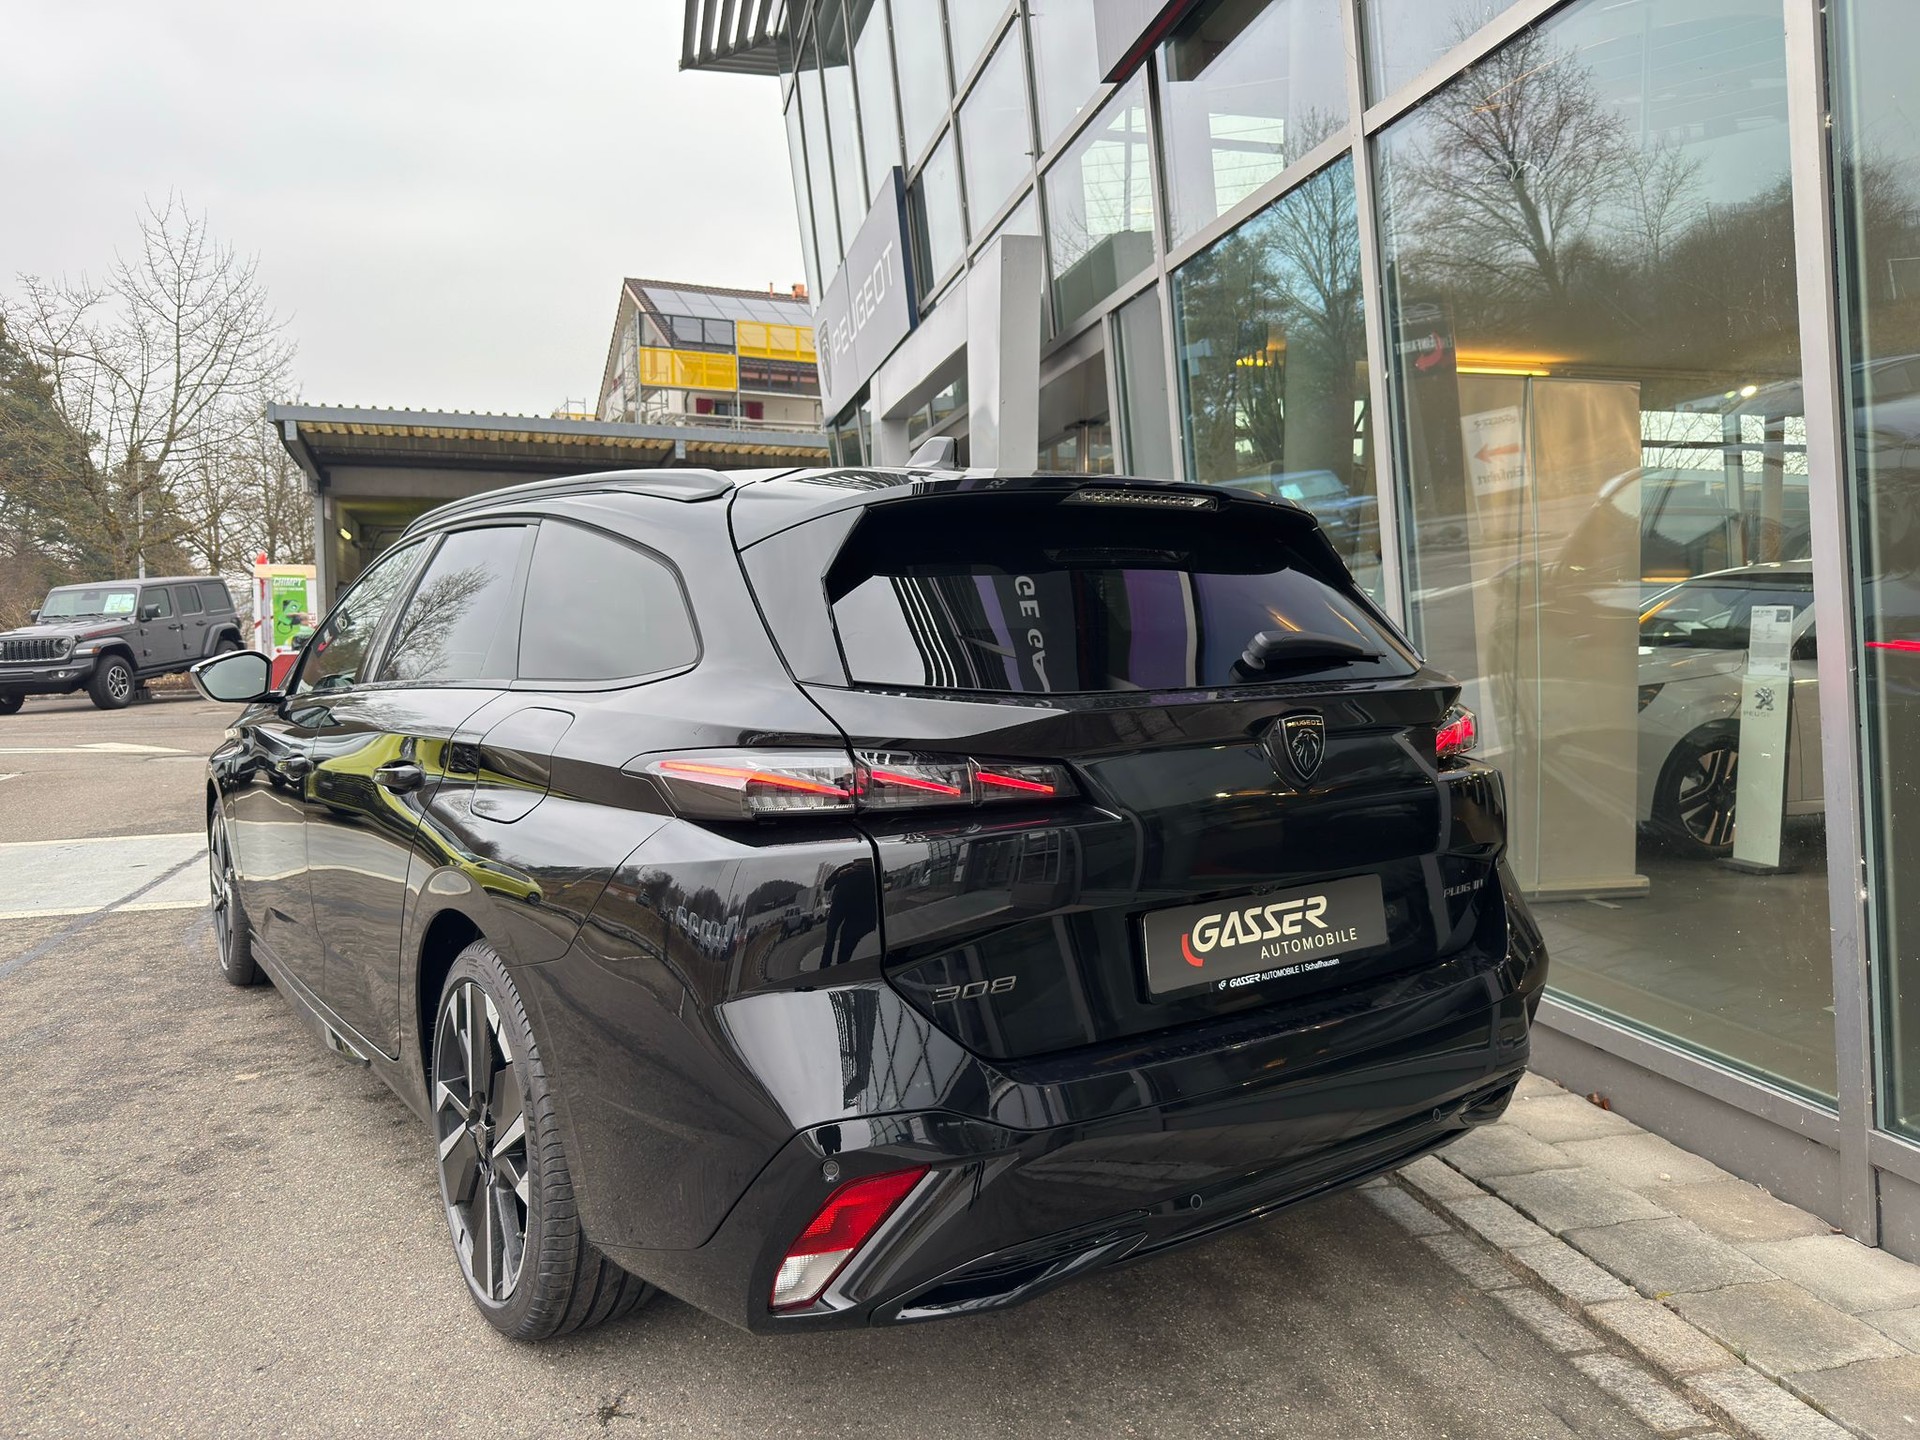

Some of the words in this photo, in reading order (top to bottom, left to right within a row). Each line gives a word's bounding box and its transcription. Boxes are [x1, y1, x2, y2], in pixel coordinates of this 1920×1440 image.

[832, 240, 894, 364] PEUGEOT
[273, 577, 303, 587] CHIMPY
[1443, 882, 1471, 899] PLUG
[1192, 895, 1328, 953] GASSER
[1260, 927, 1358, 960] AUTOMOBILE
[1229, 974, 1261, 988] GASSER
[1261, 965, 1300, 981] AUTOMOBILE
[1305, 958, 1340, 972] Schaffhausen
[932, 975, 1017, 1005] 308
